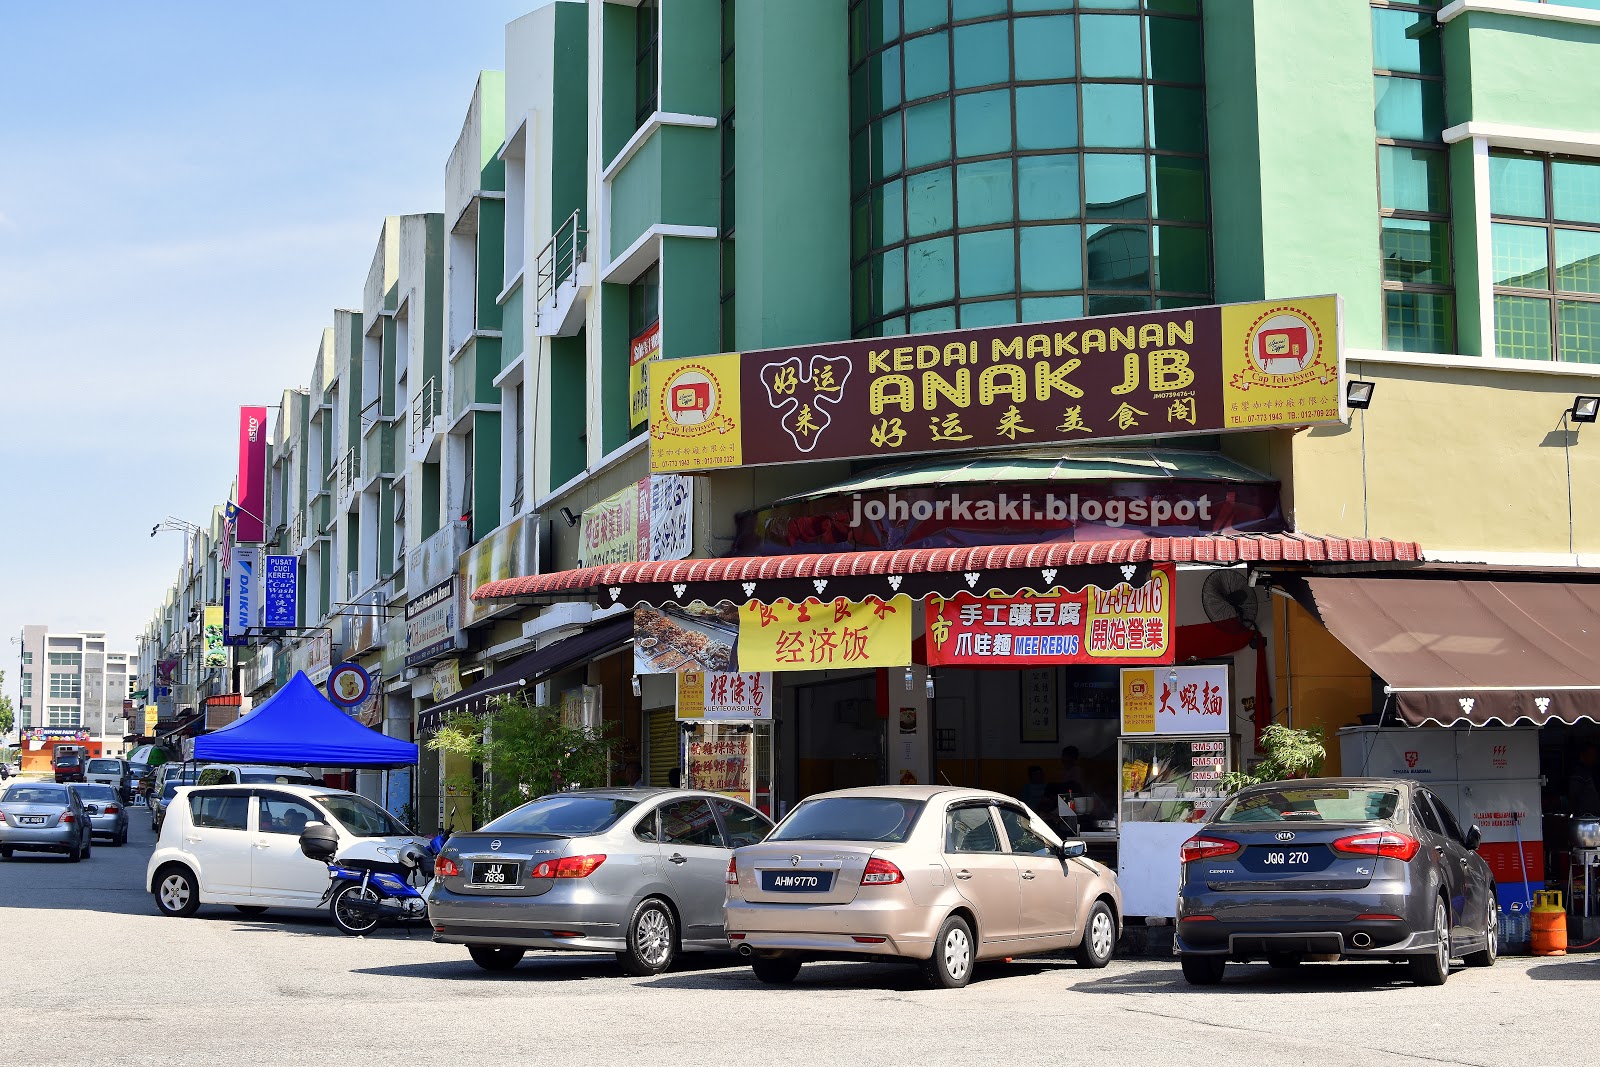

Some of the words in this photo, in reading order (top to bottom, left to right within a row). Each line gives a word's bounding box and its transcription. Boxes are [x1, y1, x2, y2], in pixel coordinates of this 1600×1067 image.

[868, 340, 978, 374] KEDAI
[991, 319, 1195, 362] MAKANAN
[868, 358, 1085, 416] ANAK
[1110, 349, 1195, 396] JB
[1251, 373, 1269, 385] Cap
[1271, 370, 1315, 383] Televisyen
[1269, 413, 1283, 421] 1943
[248, 417, 258, 443] astro
[666, 423, 680, 433] Cap
[681, 421, 716, 433] Televisyen
[270, 558, 293, 566] PUSAT
[239, 574, 249, 628] DAIKIN
[959, 602, 1082, 627] 手工釀豆腐
[1090, 616, 1164, 651] 開始營業
[775, 625, 870, 664] 经济饭
[954, 632, 1013, 656] 爪哇麵
[1013, 635, 1040, 656] MEE
[1040, 634, 1080, 655] REBUS
[1191, 742, 1224, 751] RM5.00
[1192, 757, 1224, 766] RM5.00
[1192, 771, 1224, 780] RM5.00
[1277, 832, 1292, 840] KIA
[1264, 852, 1285, 864] JQQ
[1288, 852, 1309, 864] 270
[487, 864, 503, 874] JLV
[484, 873, 505, 883] 7839
[774, 876, 793, 887] AHM
[794, 876, 818, 887] 9770
